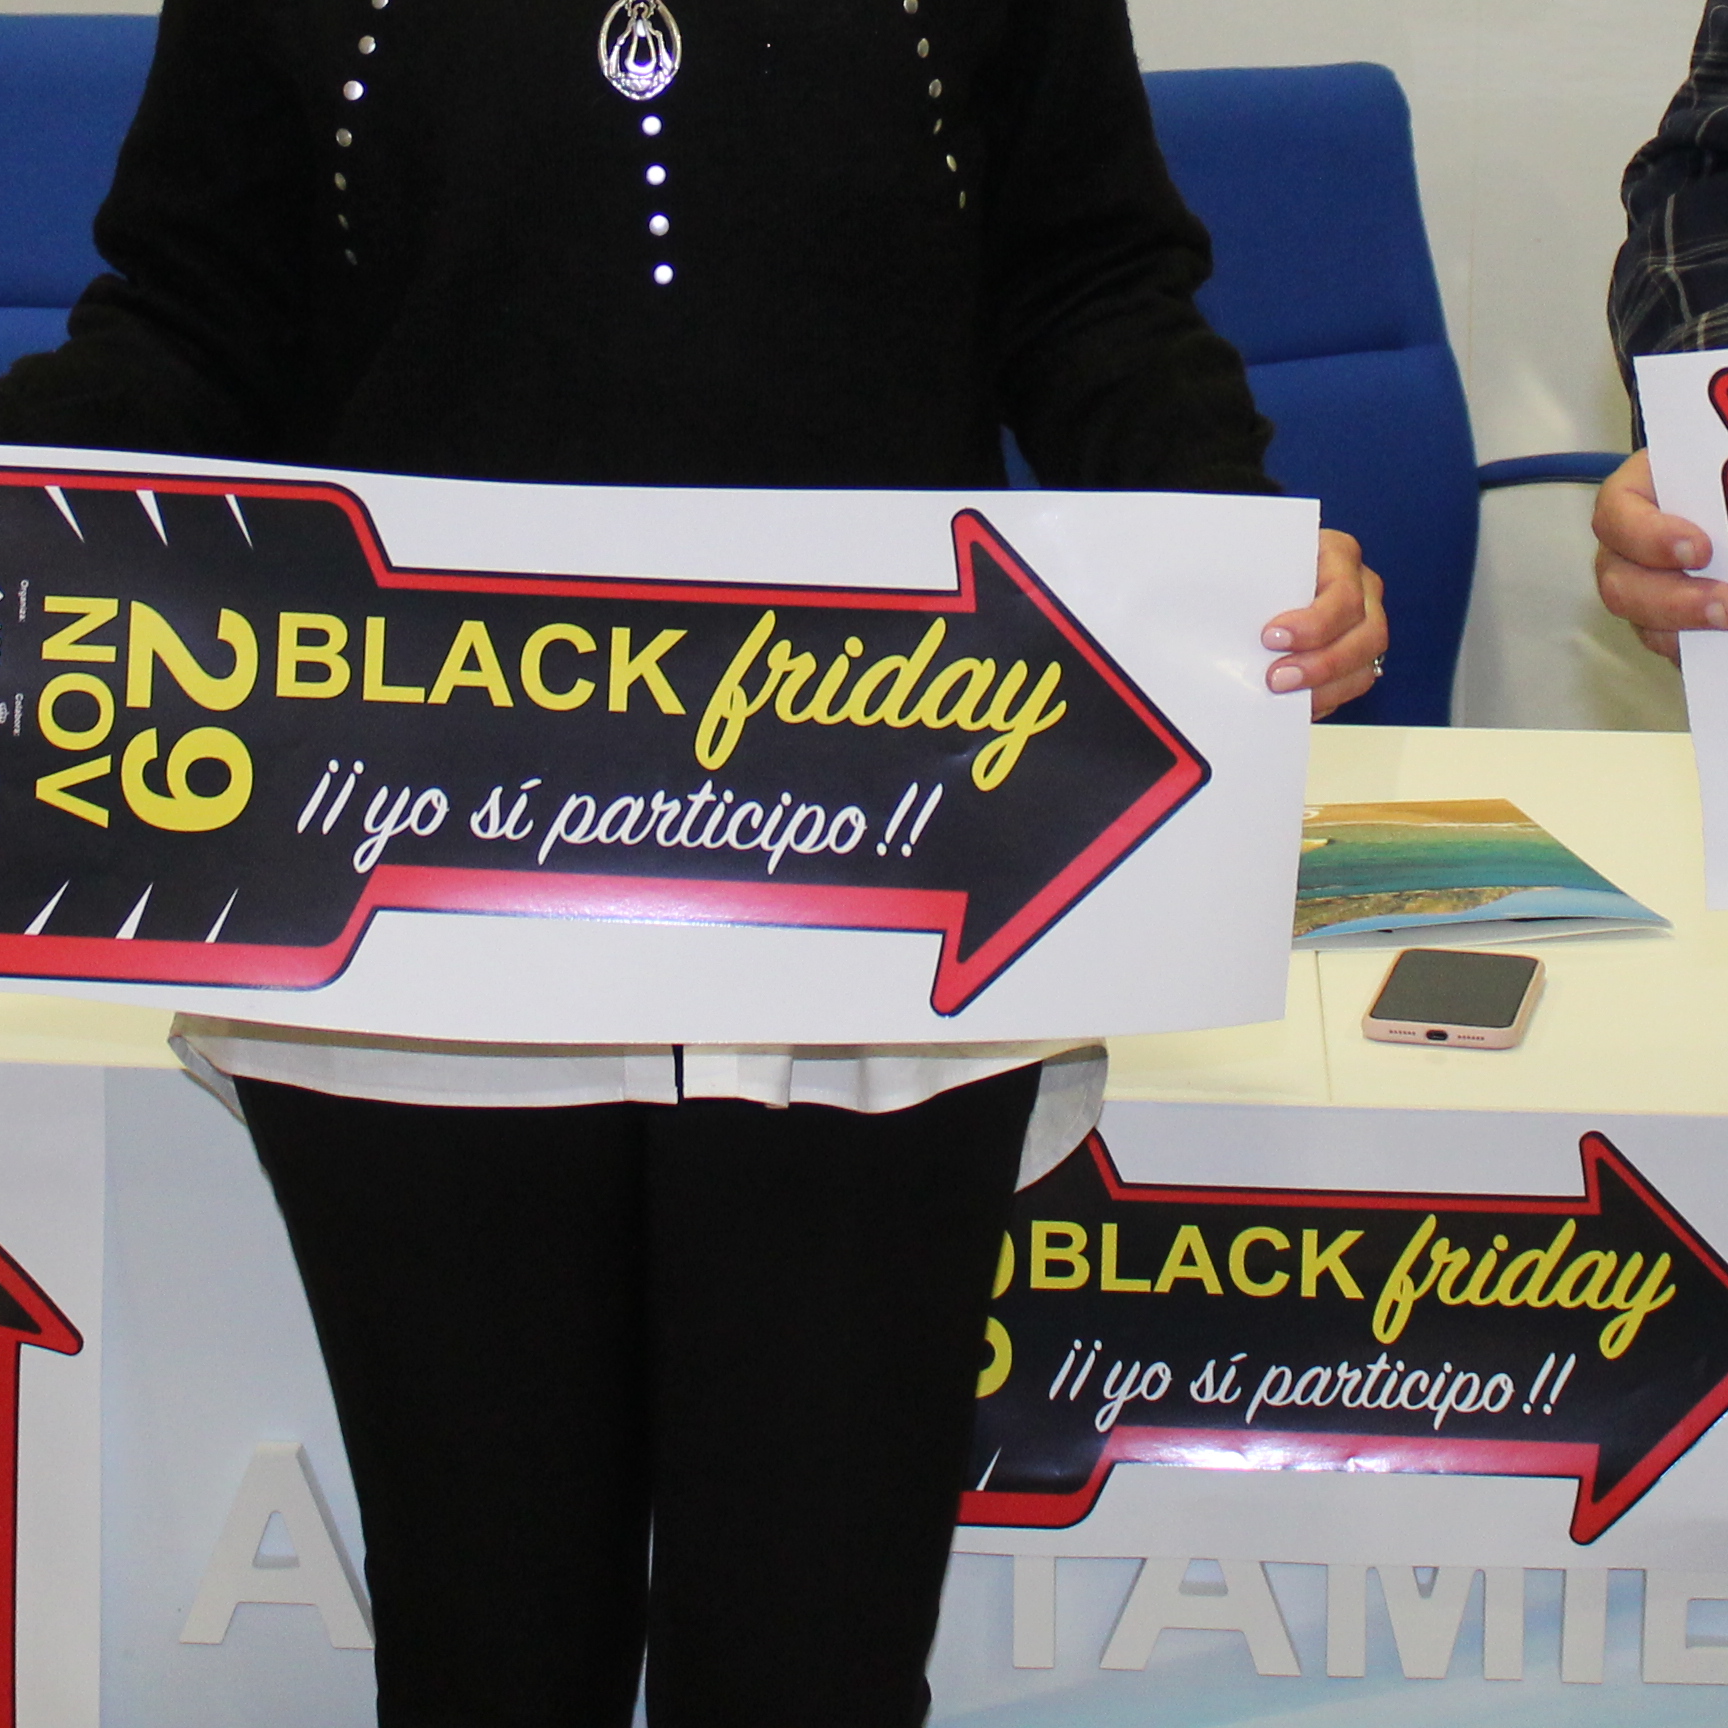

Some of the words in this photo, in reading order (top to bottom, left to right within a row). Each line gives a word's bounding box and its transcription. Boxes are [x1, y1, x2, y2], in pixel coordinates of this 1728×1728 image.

[35, 595, 119, 828] NOV
[120, 601, 259, 832] 29
[275, 611, 688, 715] BLACK
[694, 610, 1067, 792] friday
[469, 778, 542, 841] sí
[1030, 1220, 1365, 1299] BLACK
[1372, 1215, 1676, 1359] friday
[1189, 1352, 1249, 1404] sí
